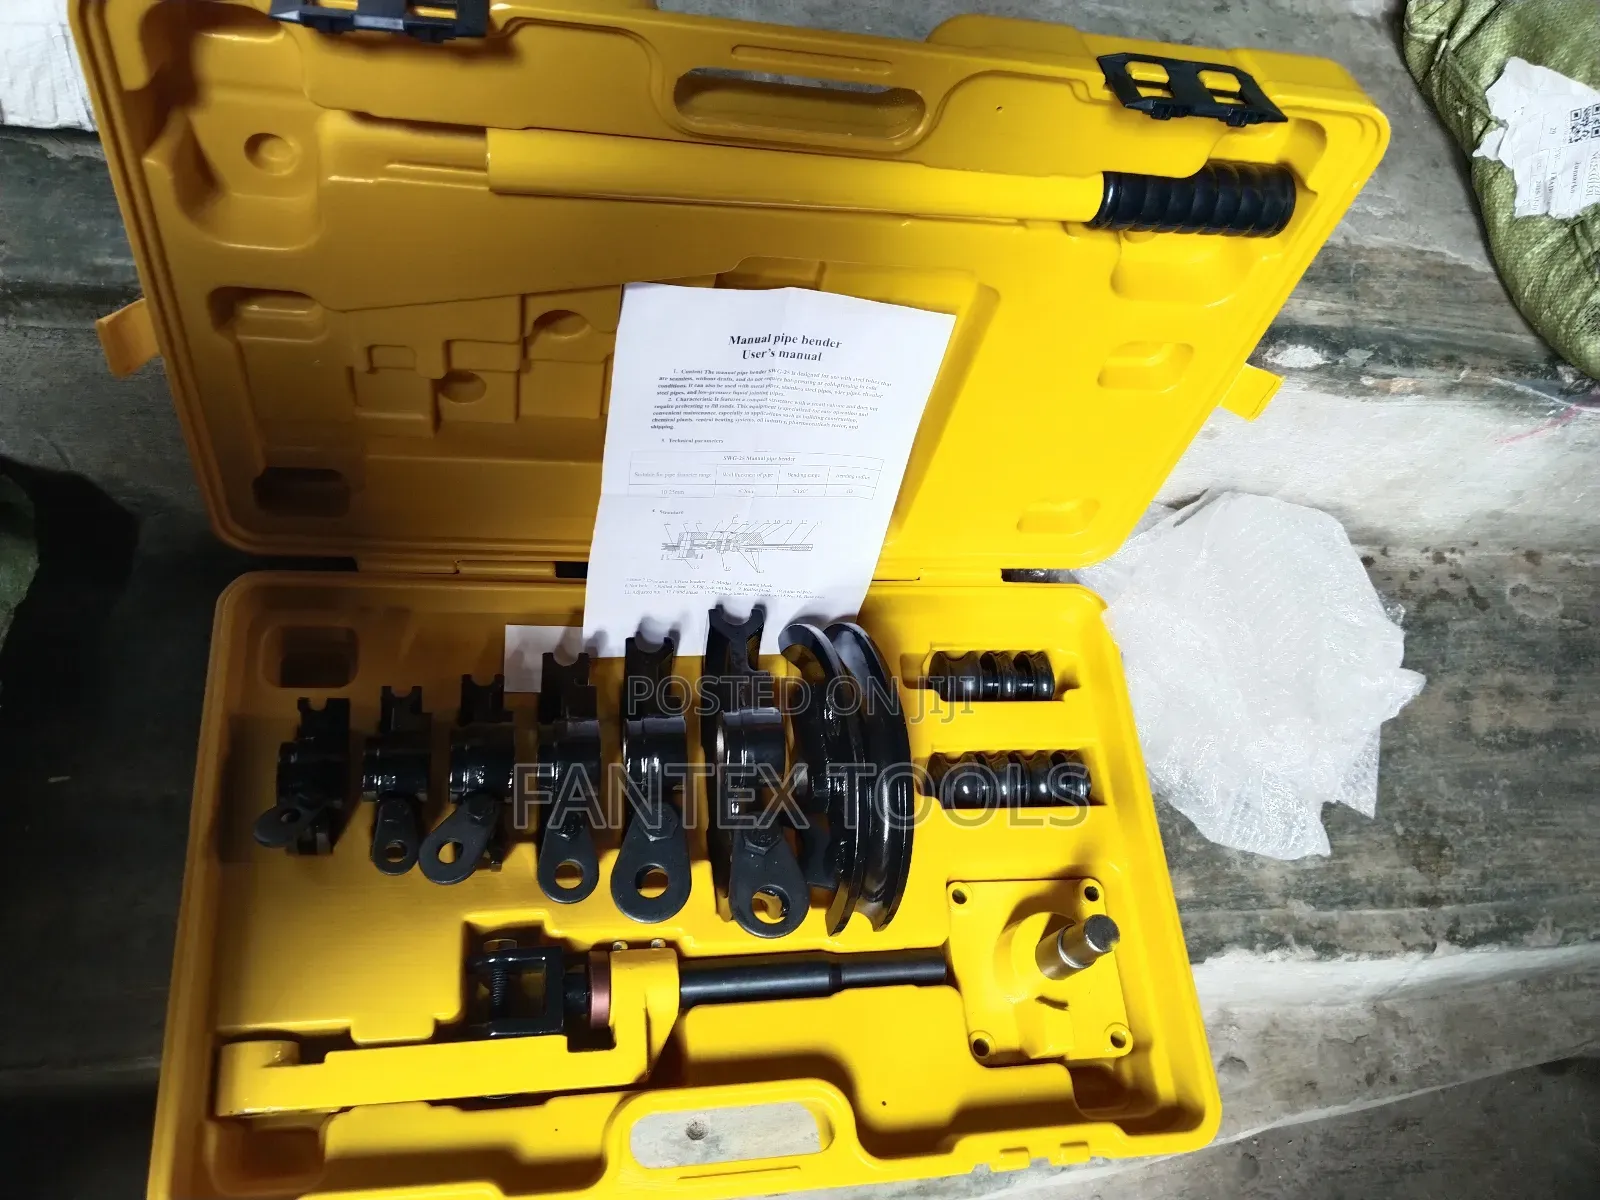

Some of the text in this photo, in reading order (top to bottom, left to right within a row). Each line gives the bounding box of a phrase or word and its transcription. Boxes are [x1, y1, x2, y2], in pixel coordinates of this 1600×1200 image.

[729, 333, 842, 348] Manual pipe bender
[742, 349, 822, 361] User's manual
